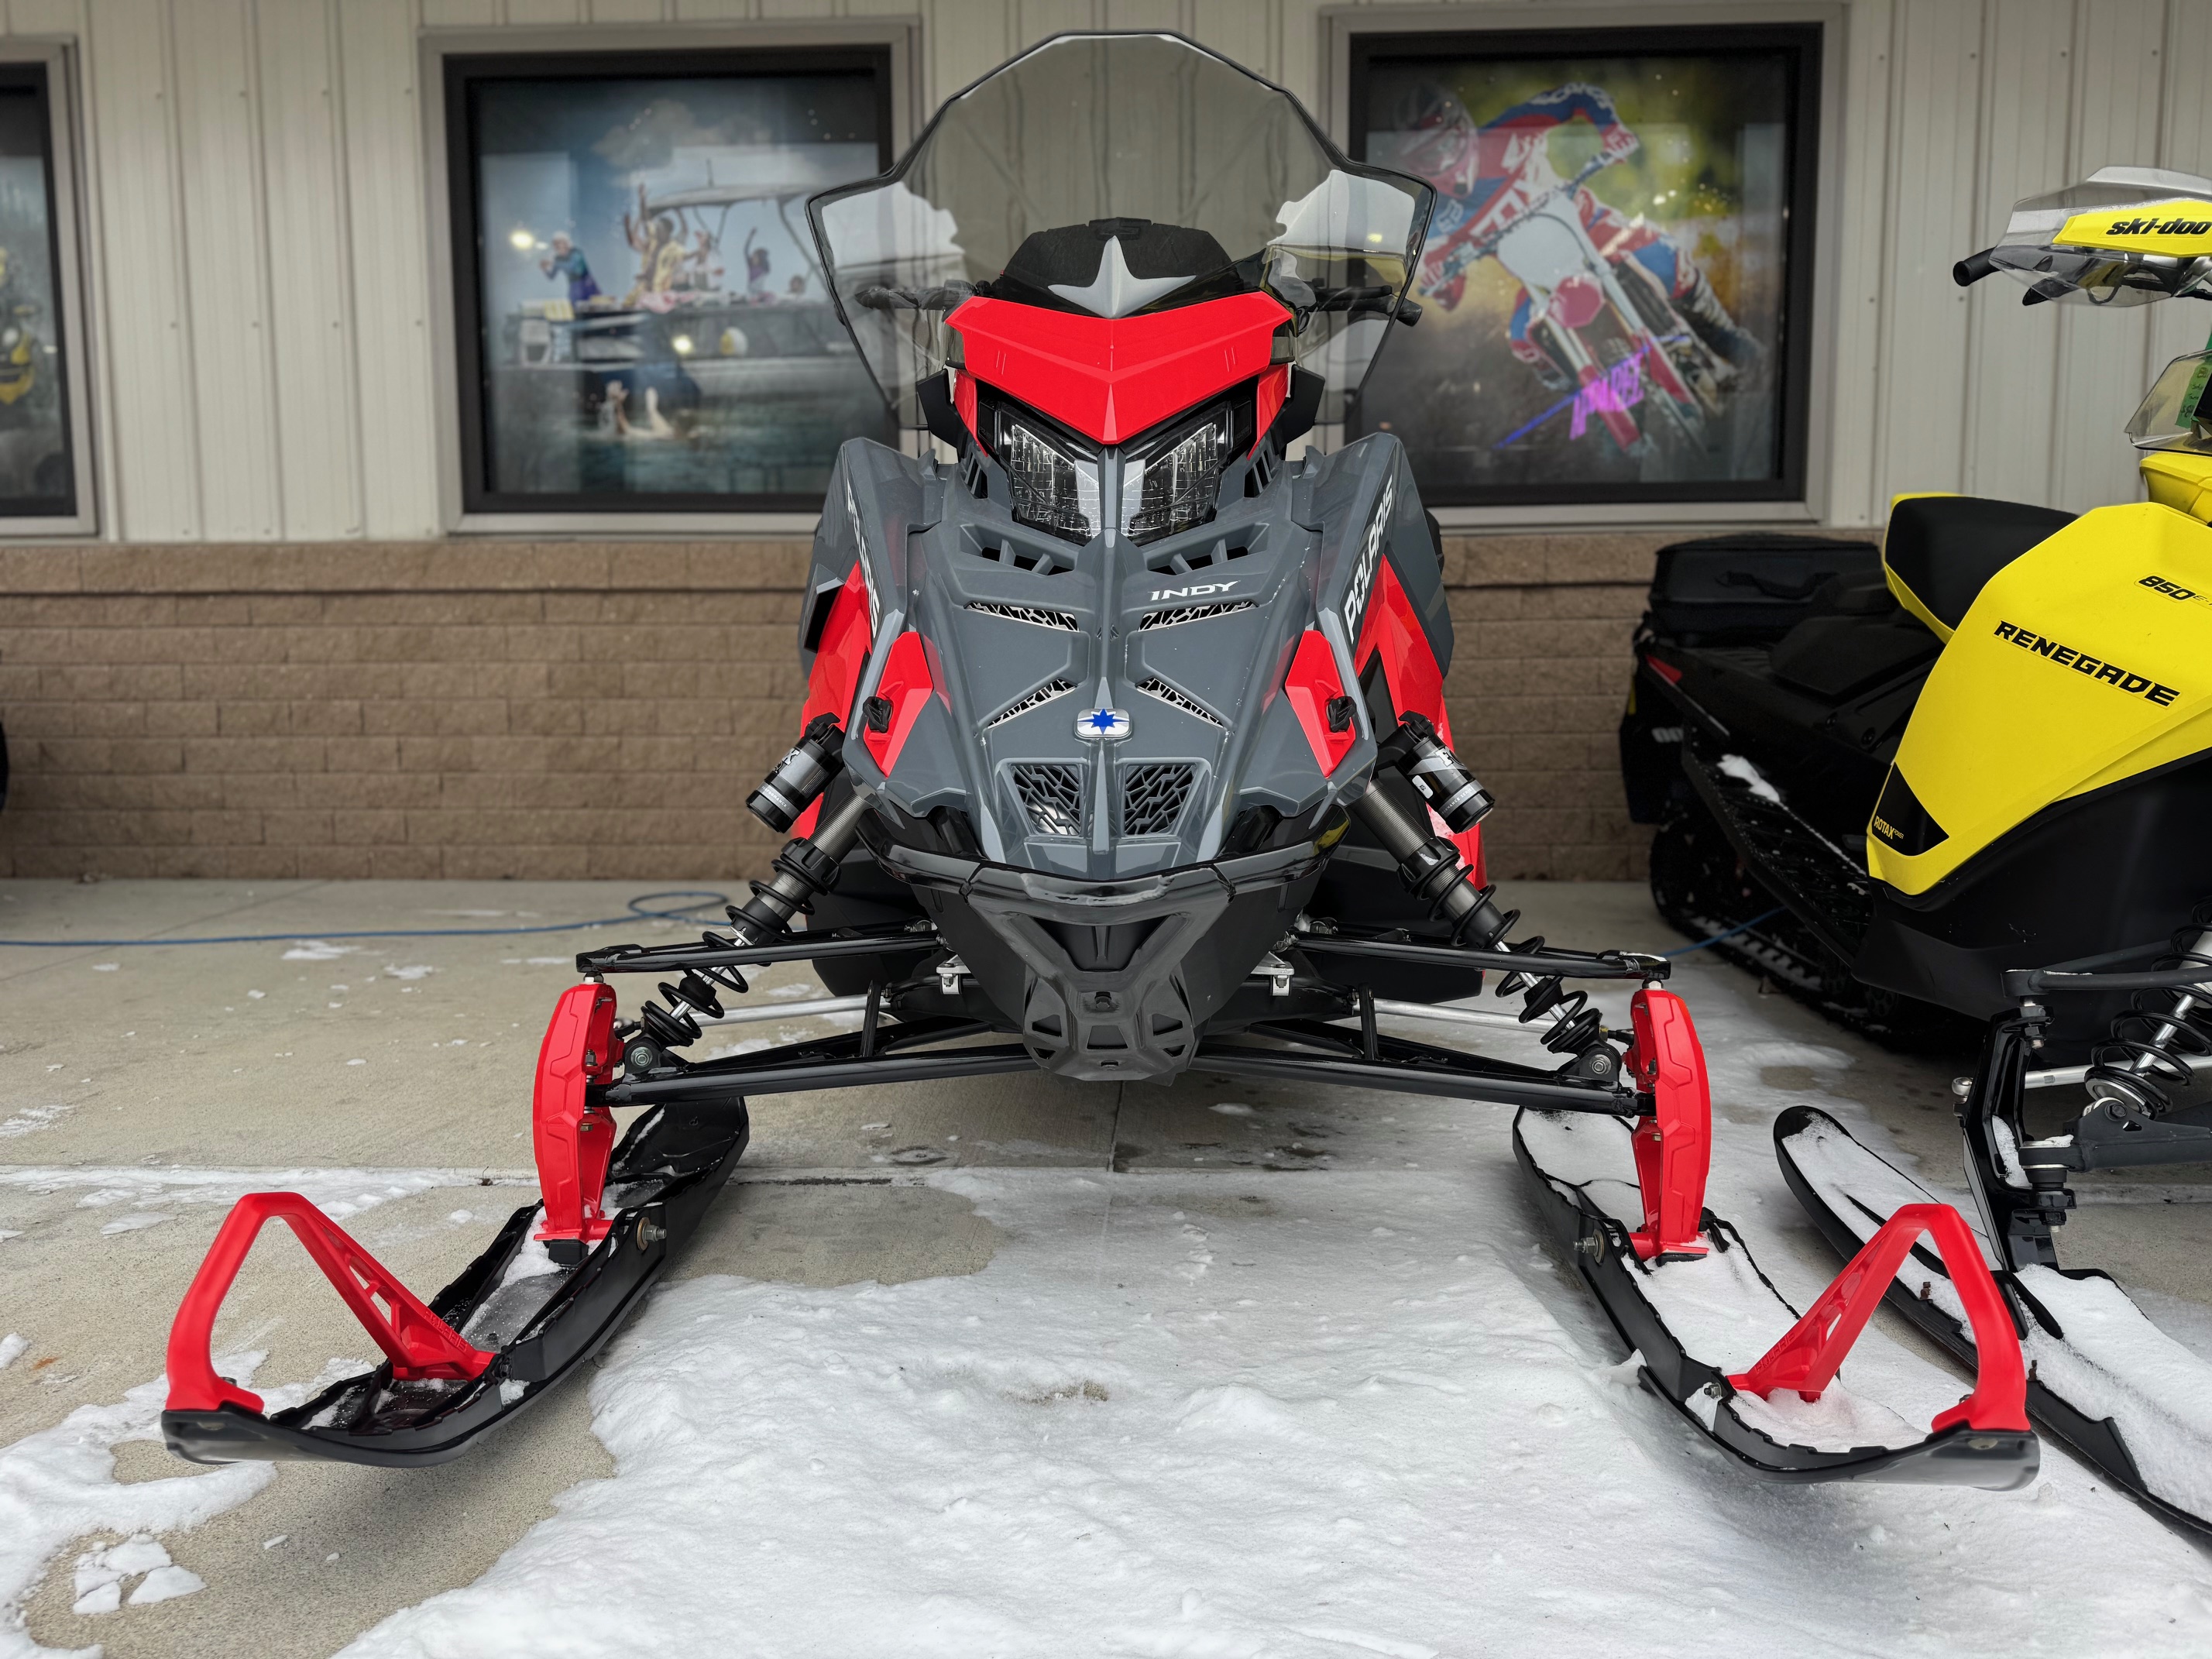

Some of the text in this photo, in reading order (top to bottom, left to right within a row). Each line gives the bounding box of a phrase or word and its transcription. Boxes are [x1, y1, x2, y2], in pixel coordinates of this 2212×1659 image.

[2106, 218, 2212, 235] ski-doo
[1344, 474, 1393, 644] POLARIS
[1148, 580, 1241, 601] INDY
[2138, 575, 2196, 600] 850
[1994, 620, 2180, 707] RENEGADE
[1874, 815, 1895, 840] ROTAX
